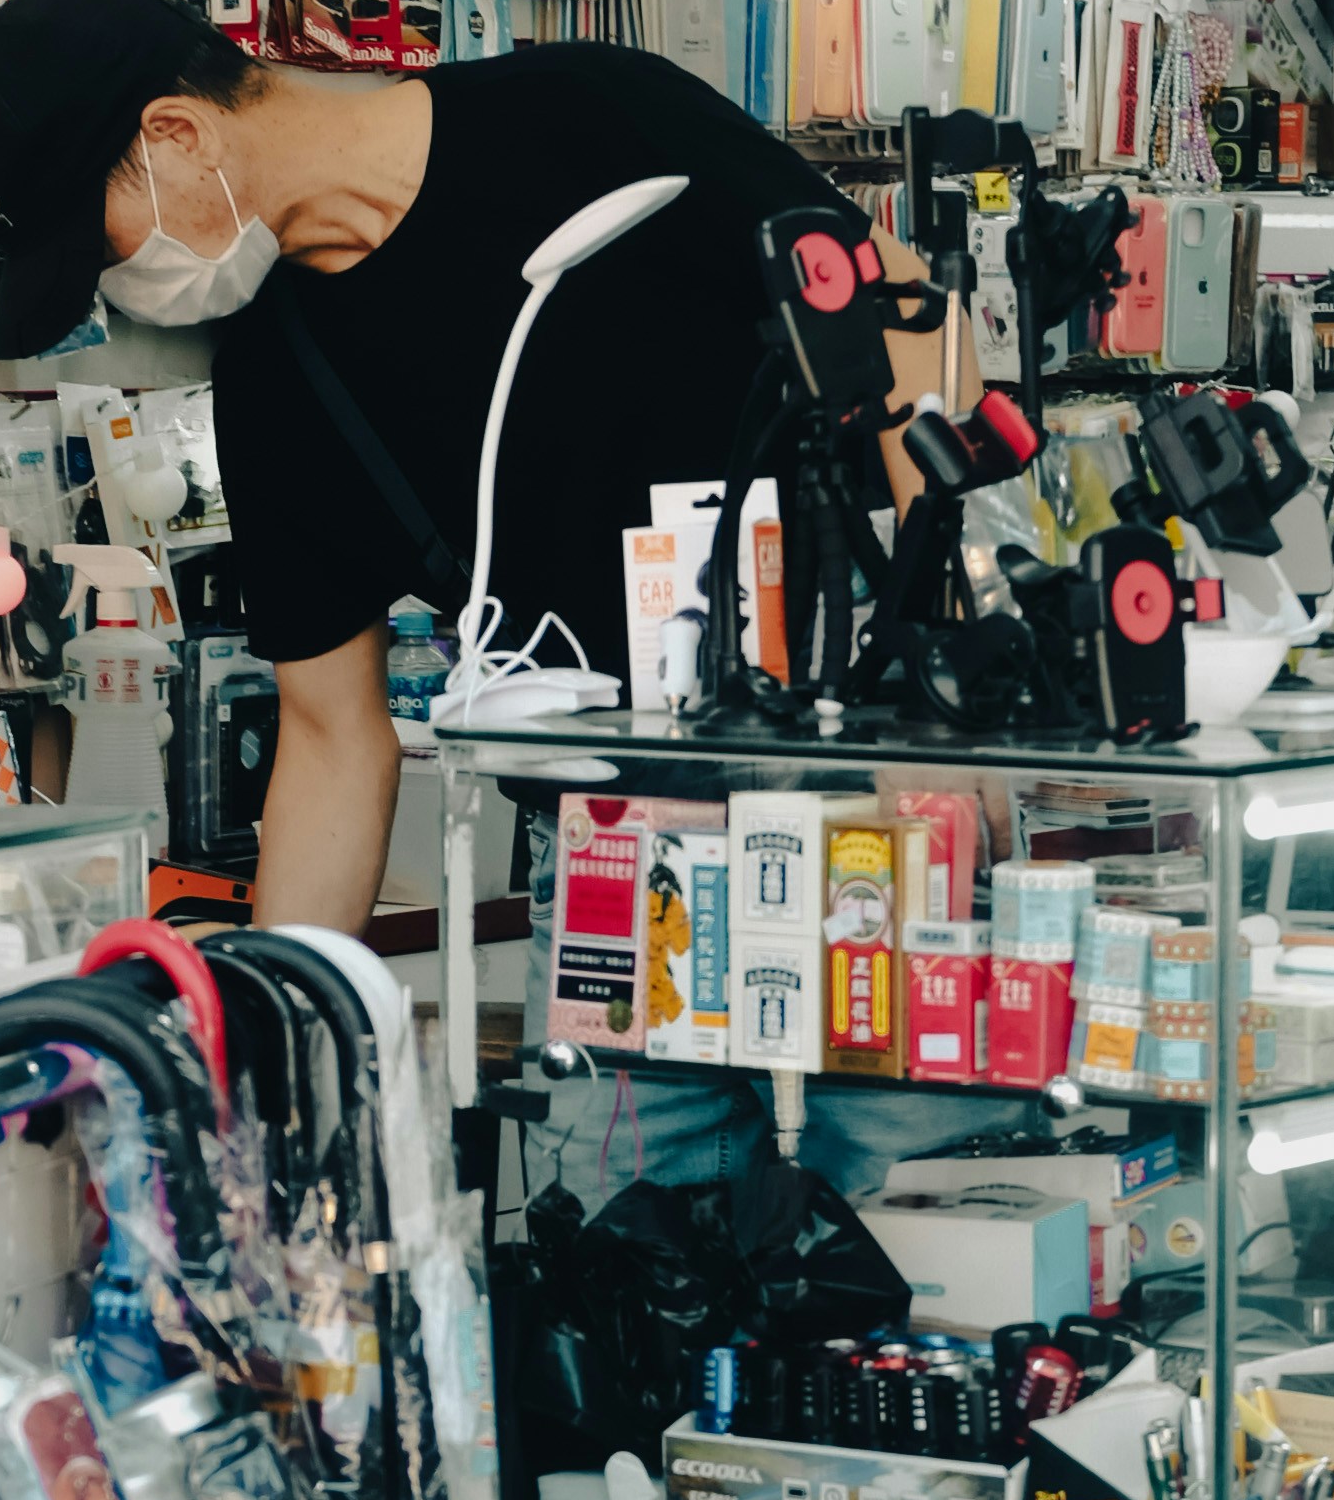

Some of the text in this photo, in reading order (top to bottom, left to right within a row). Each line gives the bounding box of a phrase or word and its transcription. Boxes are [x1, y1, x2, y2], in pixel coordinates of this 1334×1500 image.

[303, 16, 352, 60] SanDisk
[351, 42, 395, 66] anDisk
[638, 580, 674, 602] CAR
[671, 1457, 763, 1486] ECOODA
